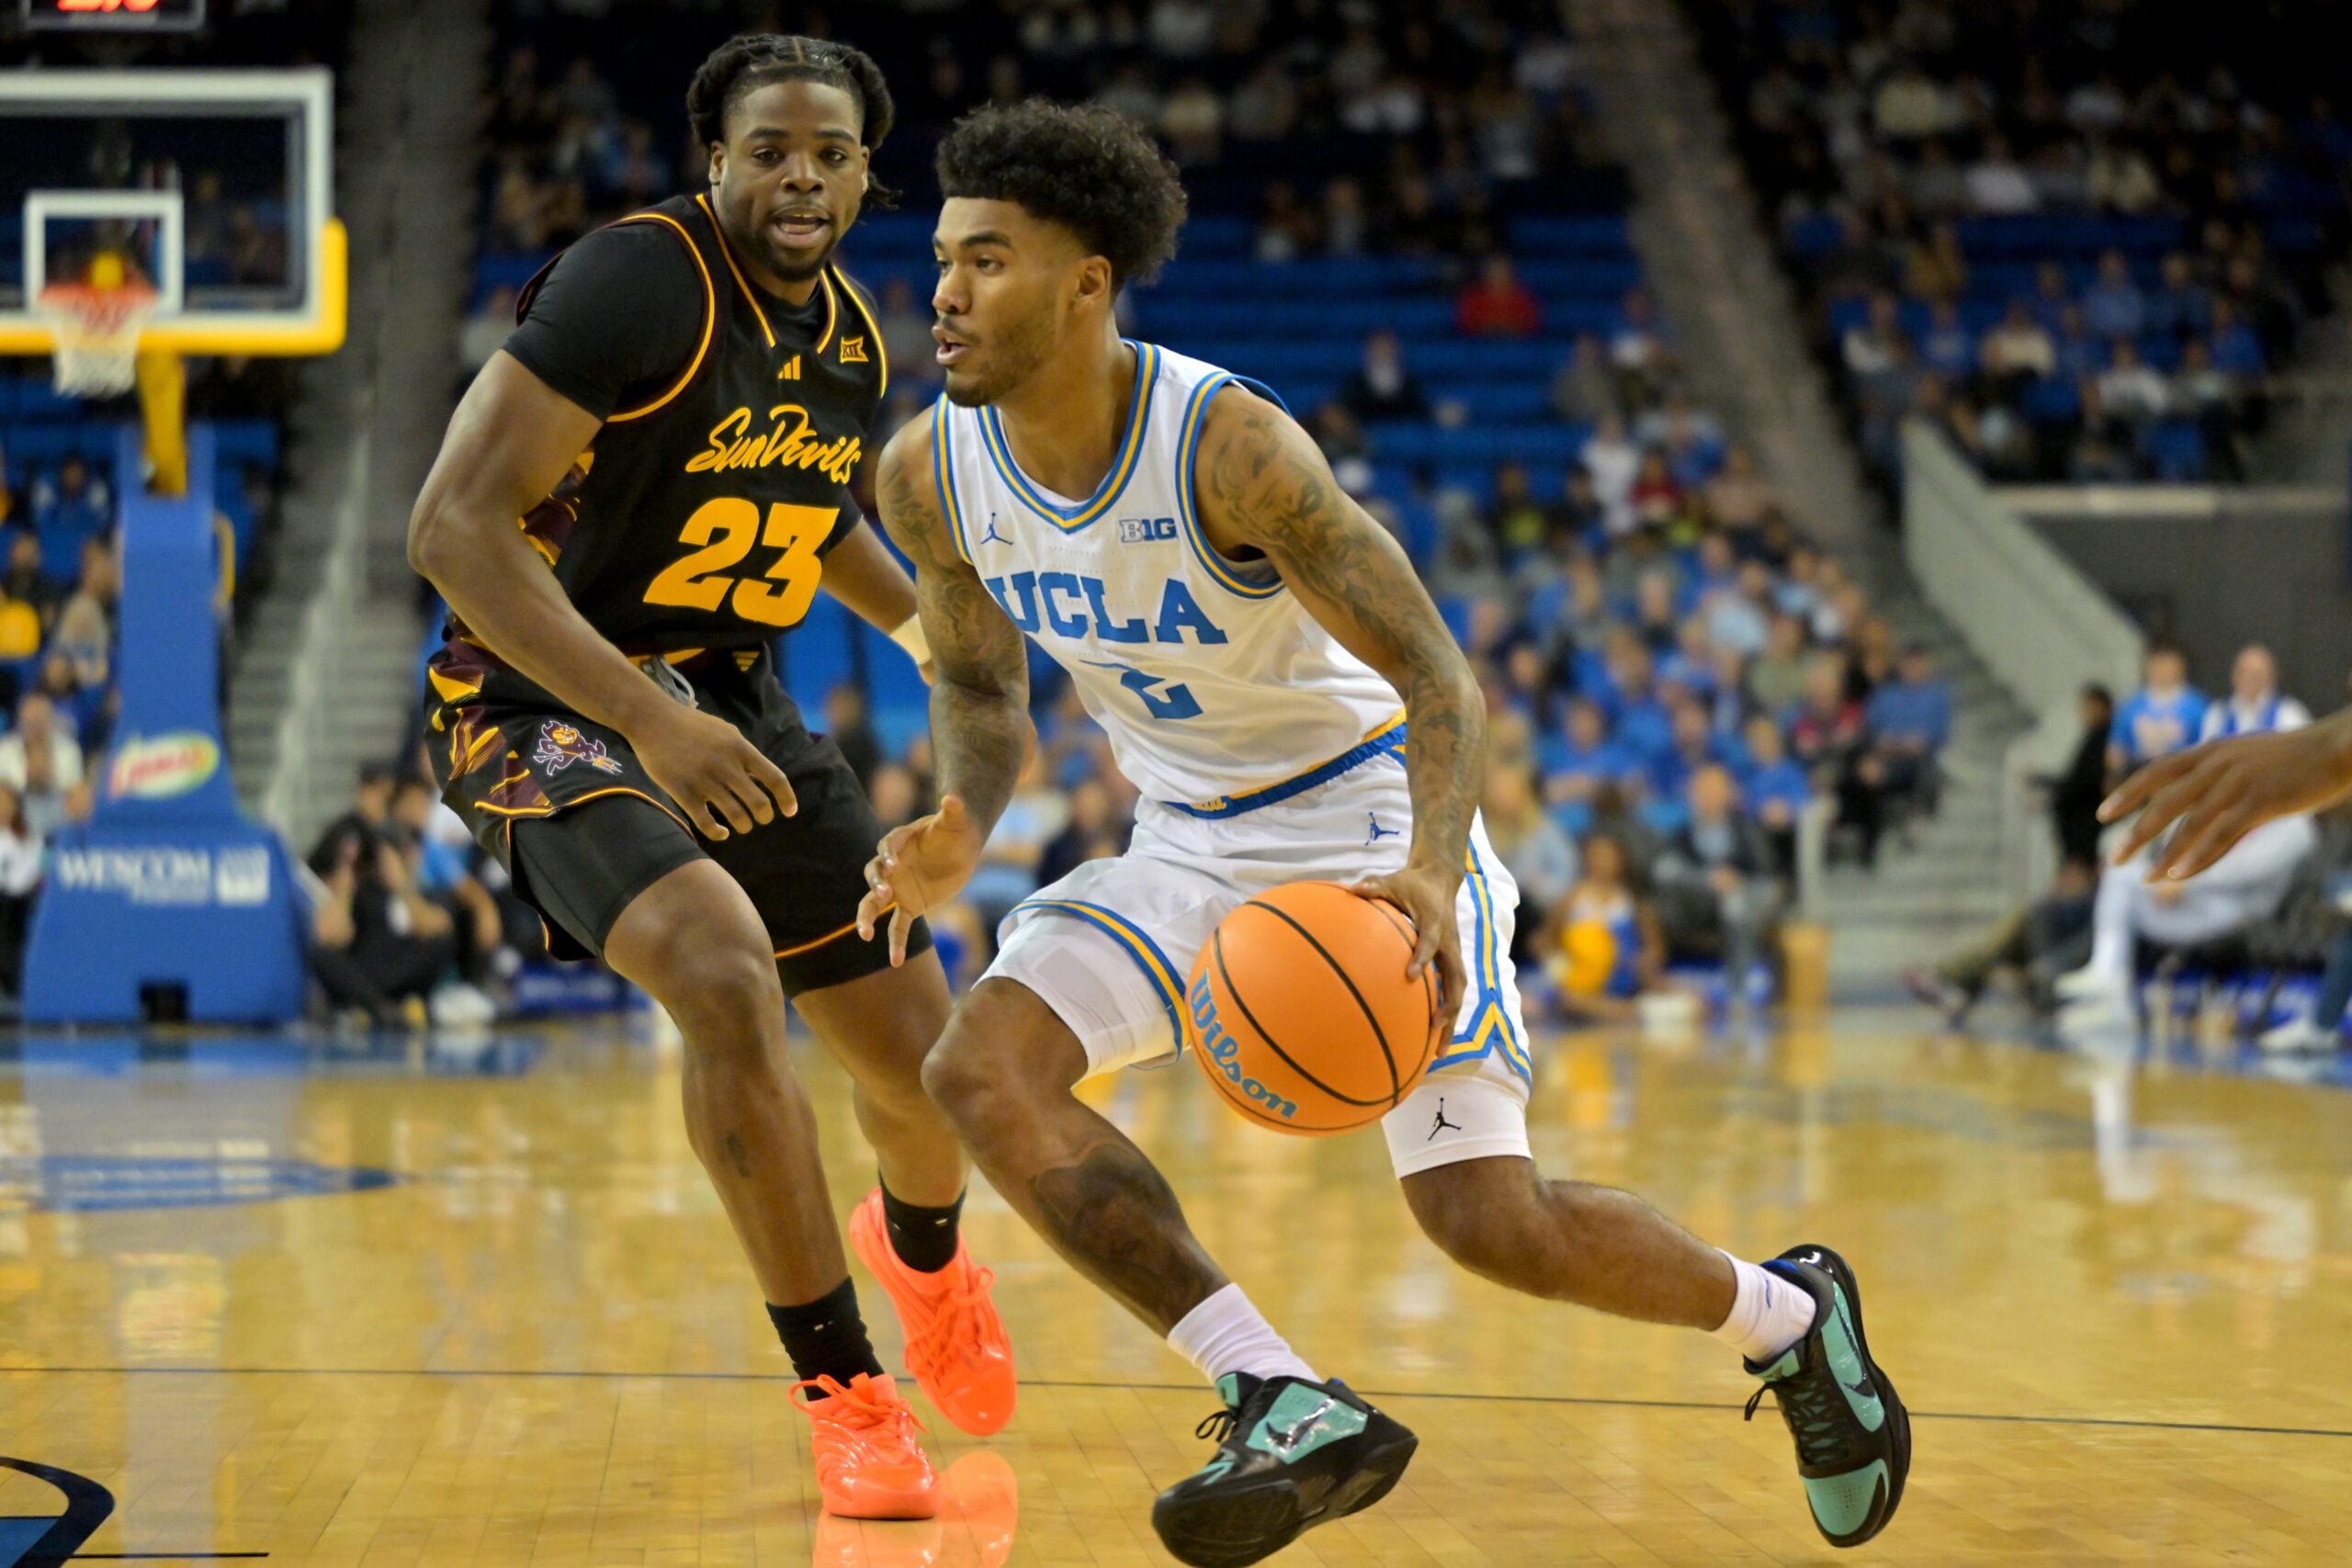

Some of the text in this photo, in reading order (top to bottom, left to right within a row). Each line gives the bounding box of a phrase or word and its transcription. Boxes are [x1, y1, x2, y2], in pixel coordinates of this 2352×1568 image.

[643, 497, 841, 627] 23
[984, 570, 1229, 644] UCLA
[1079, 660, 1204, 719] 2
[1191, 967, 1297, 1118] Wilson
